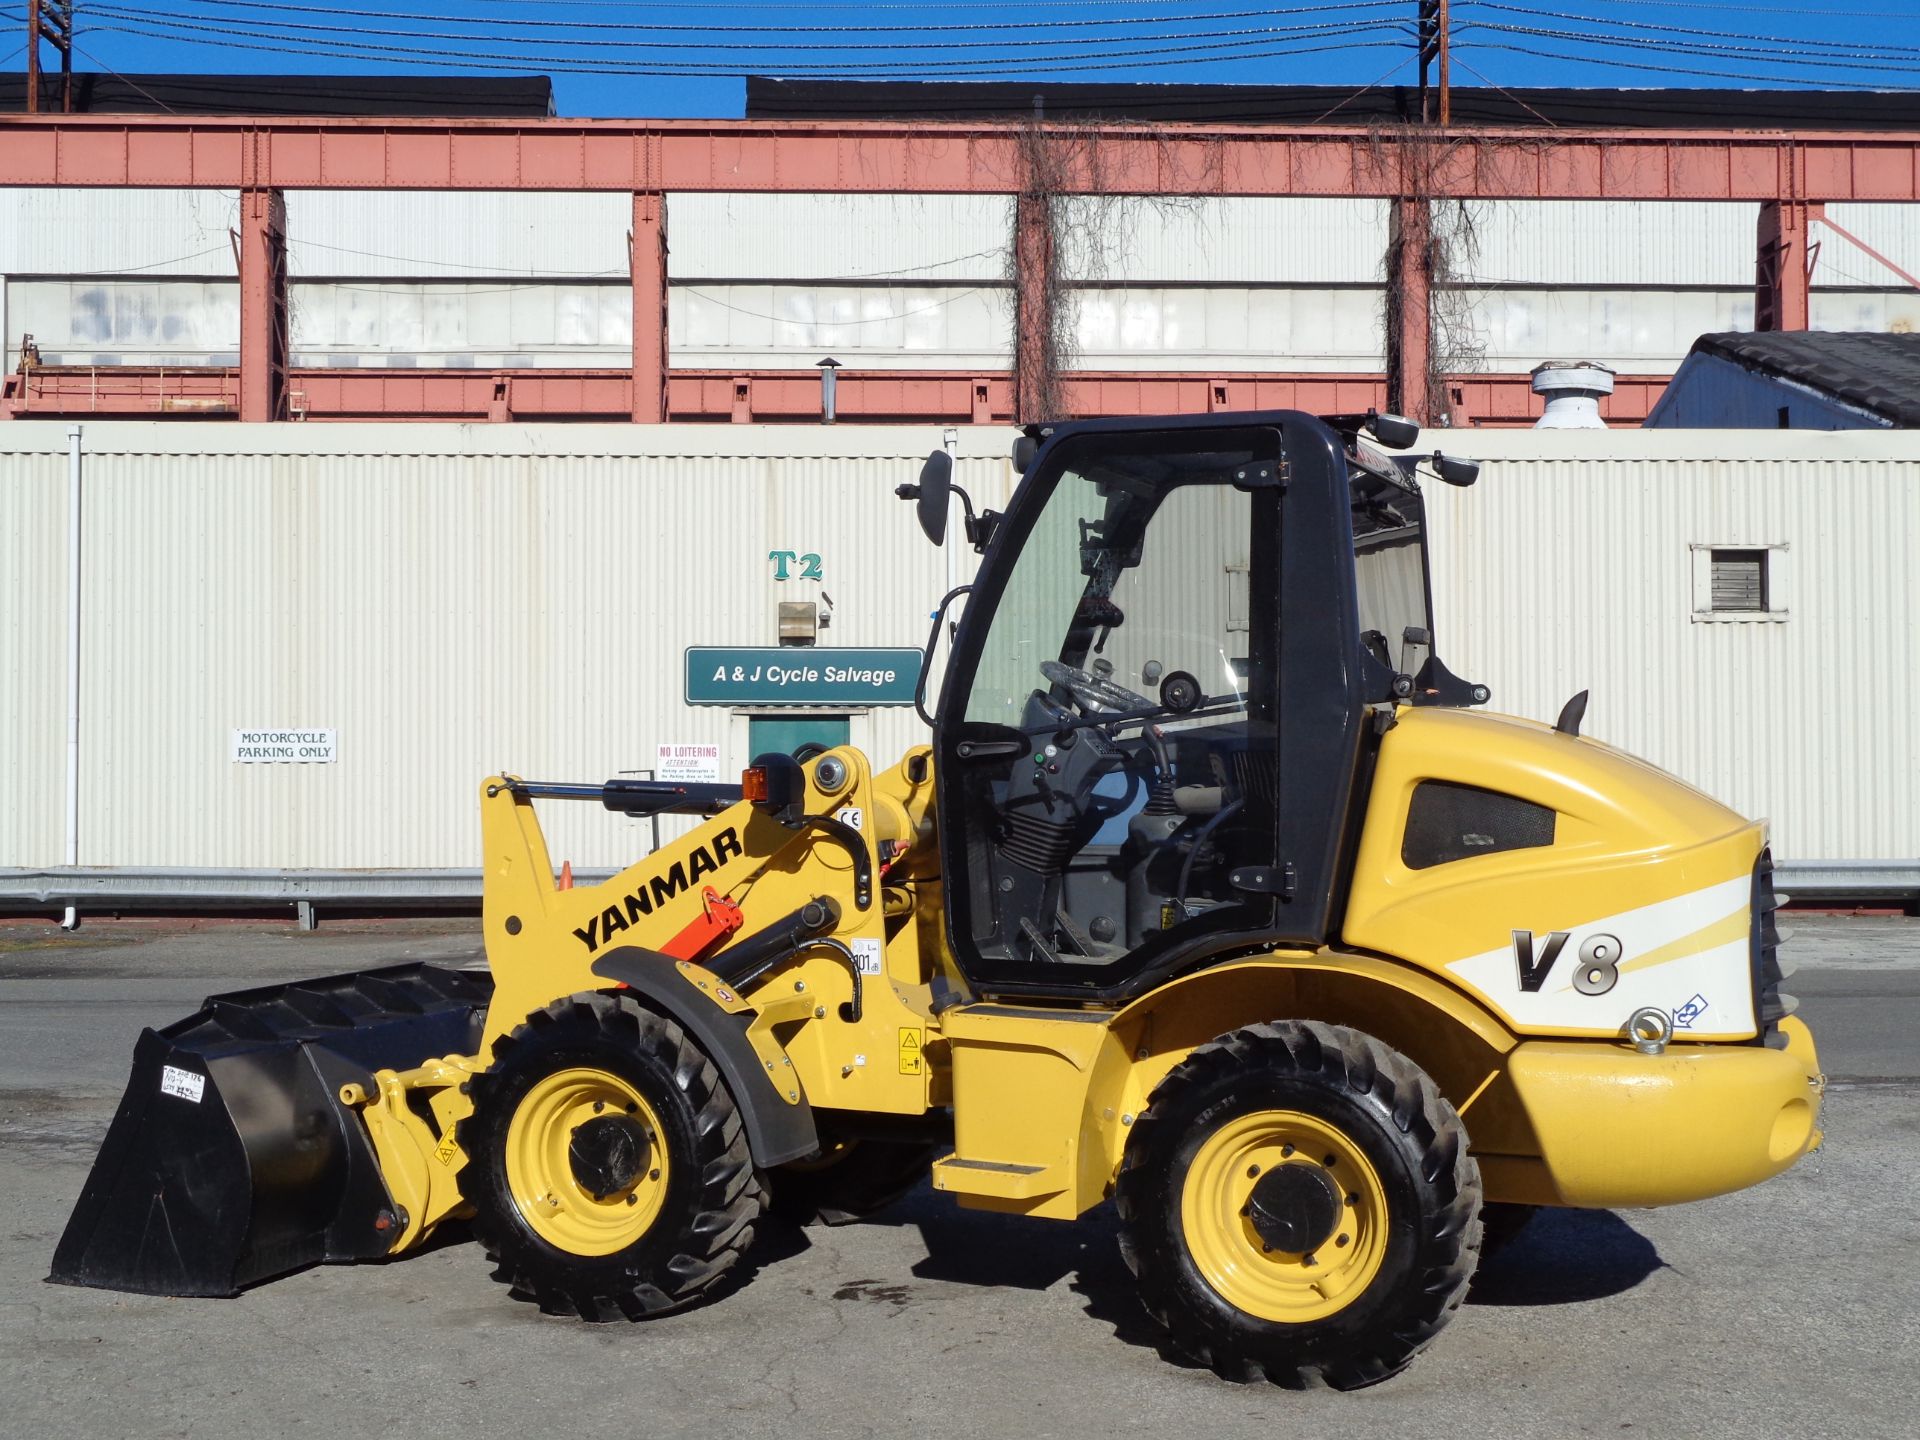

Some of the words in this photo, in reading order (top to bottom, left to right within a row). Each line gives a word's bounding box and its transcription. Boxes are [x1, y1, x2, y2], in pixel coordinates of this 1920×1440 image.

[768, 550, 823, 581] T2
[713, 666, 727, 682] A
[732, 666, 745, 682] &
[750, 666, 762, 682] J
[767, 666, 818, 686] Cycle
[824, 666, 896, 686] Salvage
[241, 733, 327, 744] MOTORCYCLE
[238, 746, 294, 758] PARKING
[299, 747, 332, 758] ONLY
[660, 746, 671, 757] NO
[675, 746, 717, 757] LOITERING
[572, 826, 743, 953] YANMAR
[1511, 929, 1622, 996] V8
